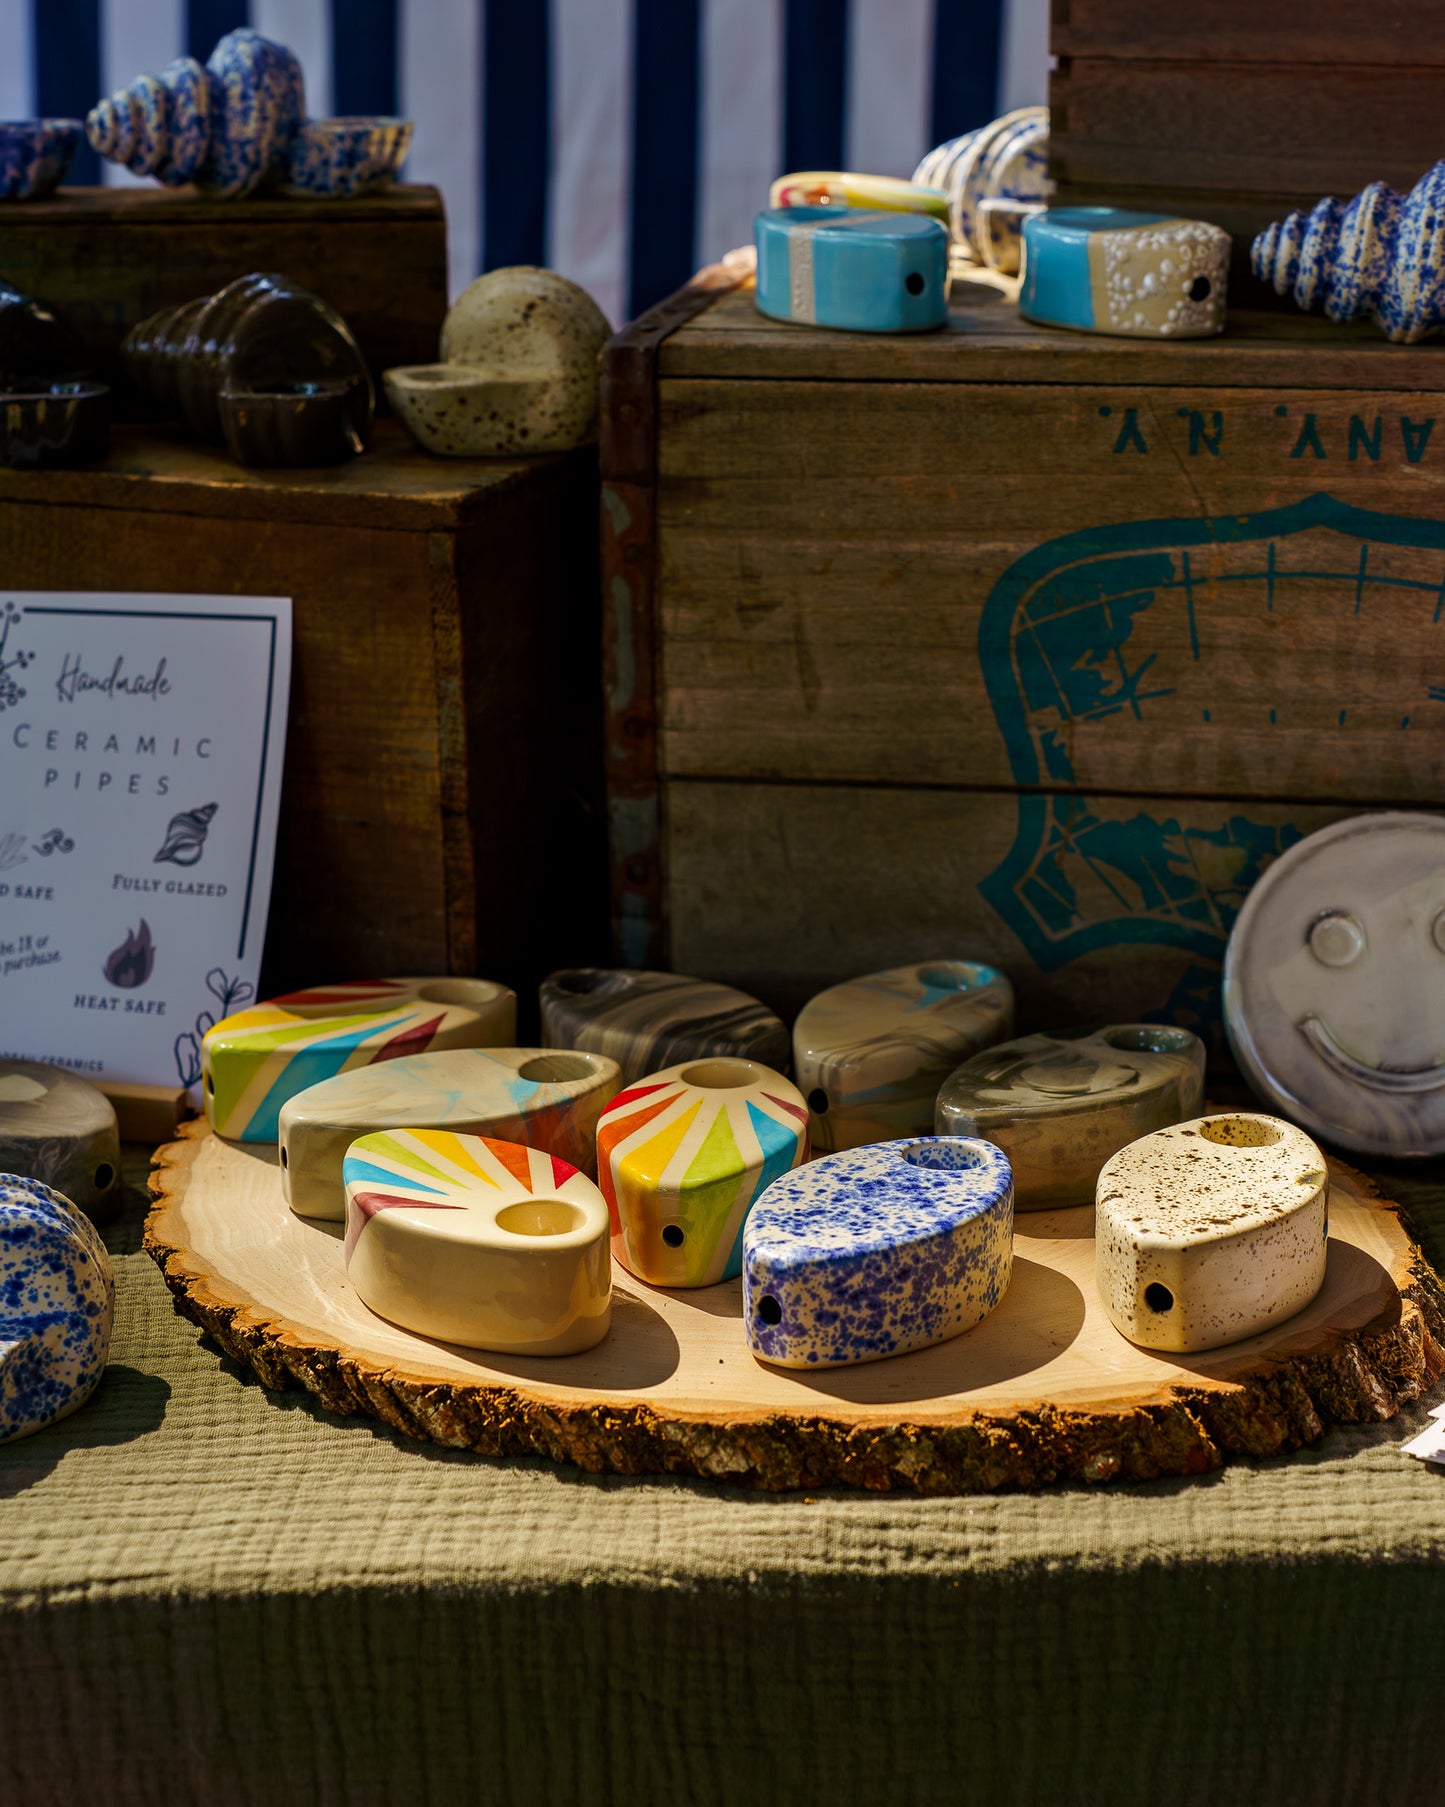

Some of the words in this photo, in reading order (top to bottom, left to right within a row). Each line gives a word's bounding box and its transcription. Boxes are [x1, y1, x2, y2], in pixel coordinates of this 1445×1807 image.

[1098, 405, 1149, 454] Y.
[55, 651, 172, 703] Handmade
[13, 723, 213, 760] CERAMIC
[44, 768, 171, 796] PIPES
[14, 884, 54, 901] SAFE
[112, 873, 161, 892] FULLY
[165, 880, 228, 898] GLAZED
[18, 934, 33, 953] 18
[35, 934, 49, 949] or
[73, 993, 120, 1011] HEAT
[124, 998, 167, 1016] SAFE
